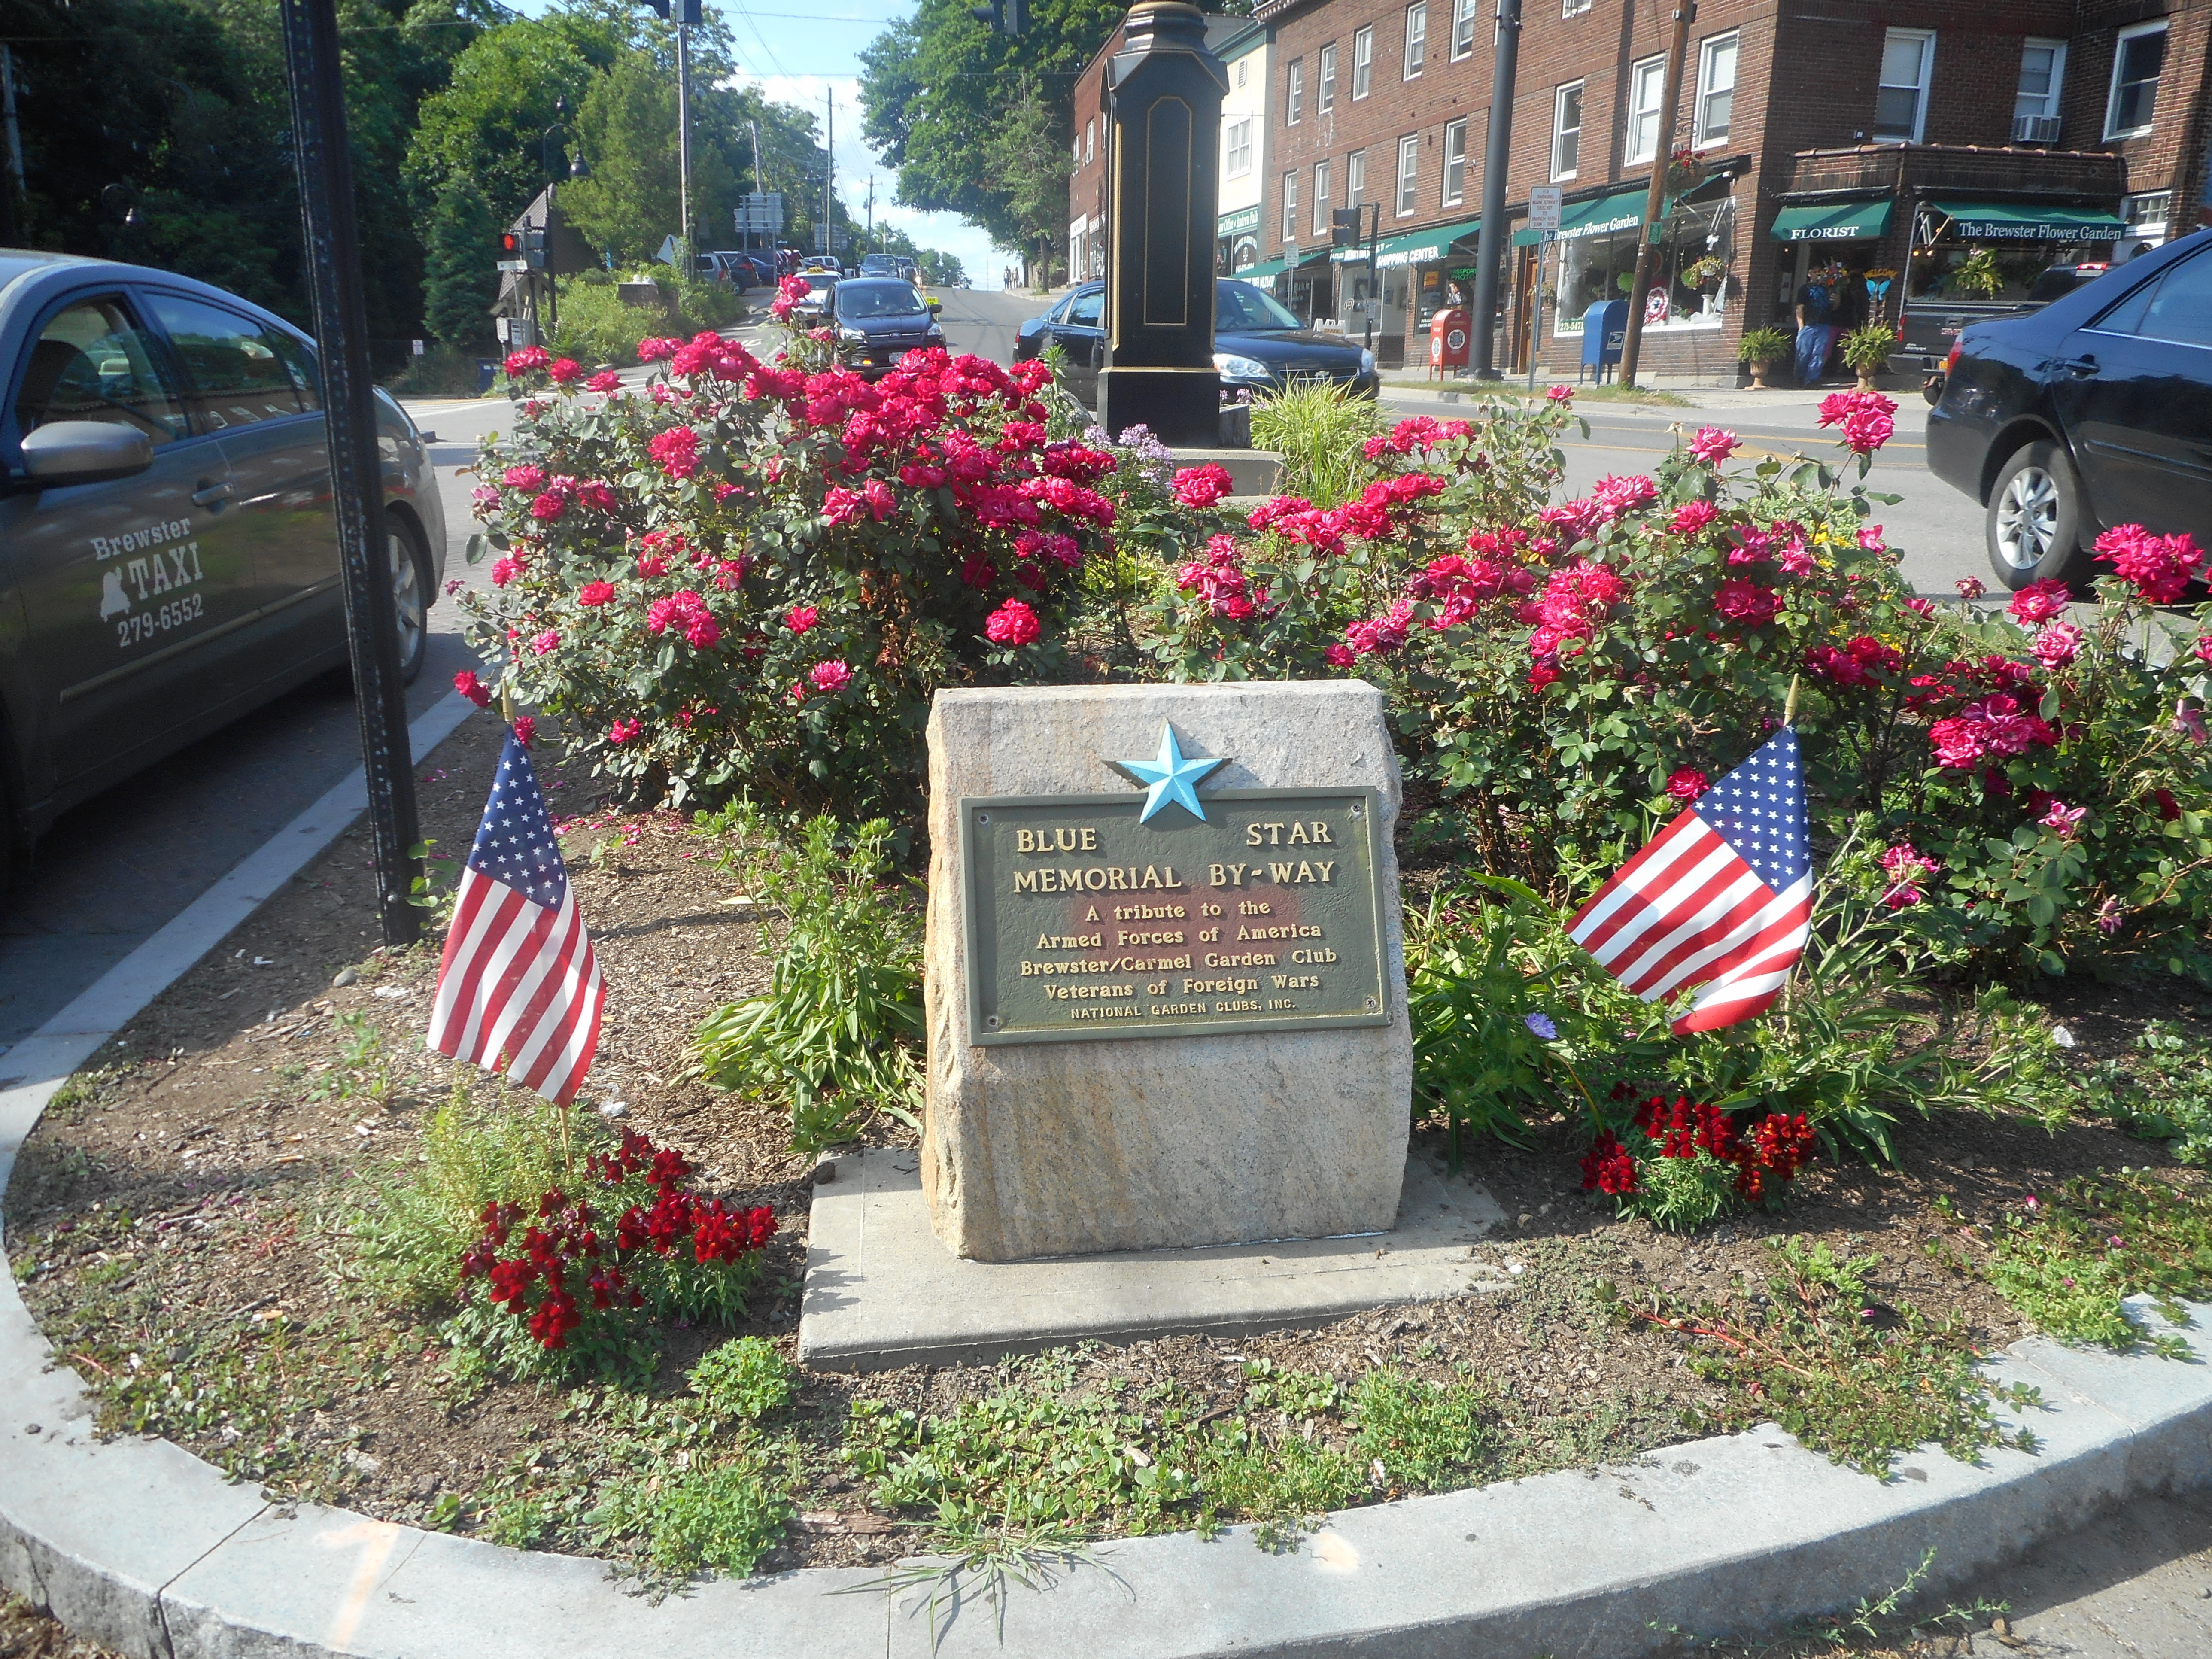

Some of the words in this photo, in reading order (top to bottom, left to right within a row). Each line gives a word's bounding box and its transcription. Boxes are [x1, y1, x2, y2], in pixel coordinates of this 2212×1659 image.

[1554, 227, 1583, 240] Brewster
[1582, 222, 1609, 235] Flower
[1610, 214, 1638, 231] Garden
[1791, 226, 1859, 240] FLORIST
[1960, 222, 1983, 237] The
[1984, 223, 2034, 238] Brewster
[2037, 224, 2077, 239] Flower
[2080, 226, 2122, 240] Garden
[1377, 252, 1408, 267] SHIPPING
[1409, 246, 1439, 262] CENTER
[1560, 322, 1584, 331] 279-5471
[90, 518, 191, 561] Brewster
[127, 542, 204, 600] TAXI
[118, 593, 204, 647] 279-6552
[1017, 827, 1097, 853] BLUE
[1246, 821, 1332, 845] STAR
[1013, 865, 1182, 893] MEMORIAL
[1208, 860, 1334, 886] BY-WAY
[1085, 905, 1100, 921] A
[1114, 904, 1185, 921] tribute
[1201, 902, 1222, 917] to
[1238, 900, 1271, 915] the
[1036, 933, 1102, 949] Armed
[1118, 930, 1184, 946] Forces
[1199, 926, 1219, 942] of
[1237, 923, 1322, 940] America
[1021, 954, 1191, 976] Brewster/Carmel
[1204, 952, 1276, 968] Garden
[1292, 947, 1337, 963] Club
[1044, 984, 1133, 1000] Veterans
[1147, 979, 1168, 995] of
[1183, 976, 1258, 995] Foreign
[1271, 975, 1319, 988] Wars
[1071, 1006, 1142, 1019] NATIONAL
[1151, 1003, 1206, 1016] GARDEN
[1215, 1000, 1262, 1012] CLUBS,
[1268, 998, 1296, 1010] INC.
